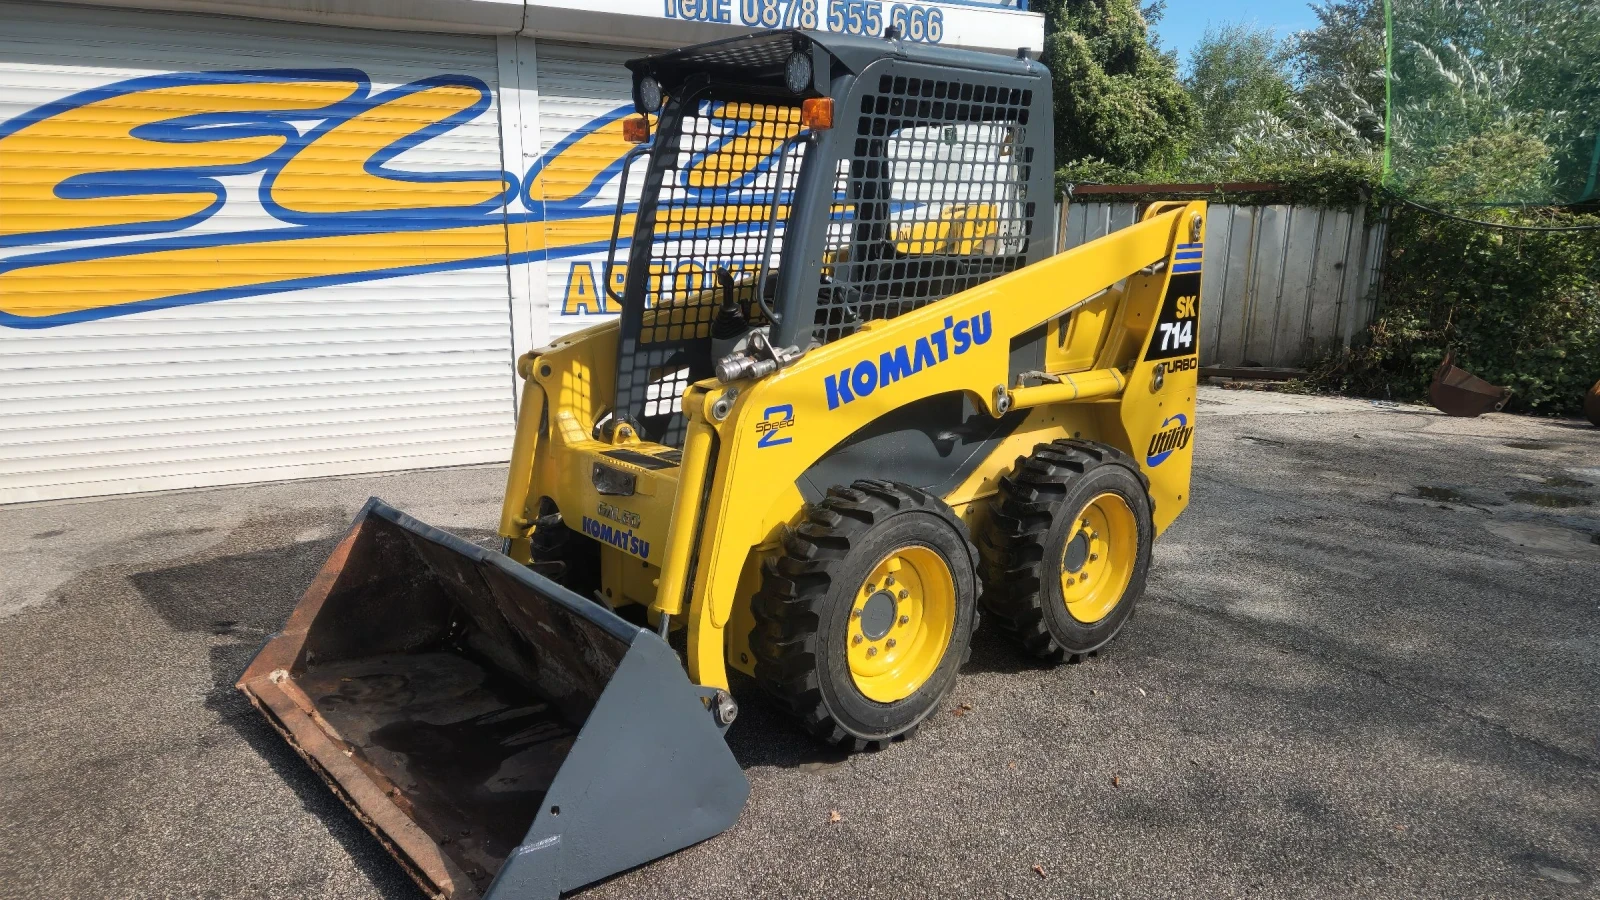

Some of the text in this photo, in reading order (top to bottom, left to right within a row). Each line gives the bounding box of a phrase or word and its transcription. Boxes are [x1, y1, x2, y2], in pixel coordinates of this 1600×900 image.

[739, 0, 819, 30] 0878
[826, 0, 883, 39] 555
[889, 3, 944, 44] 666
[1176, 295, 1197, 319] SK
[1160, 320, 1193, 351] 714
[824, 310, 992, 411] KOMATSU
[1162, 357, 1198, 374] TURBO
[758, 403, 794, 449] 2
[1147, 426, 1194, 456] Utility
[582, 515, 650, 559] KOMATSU
